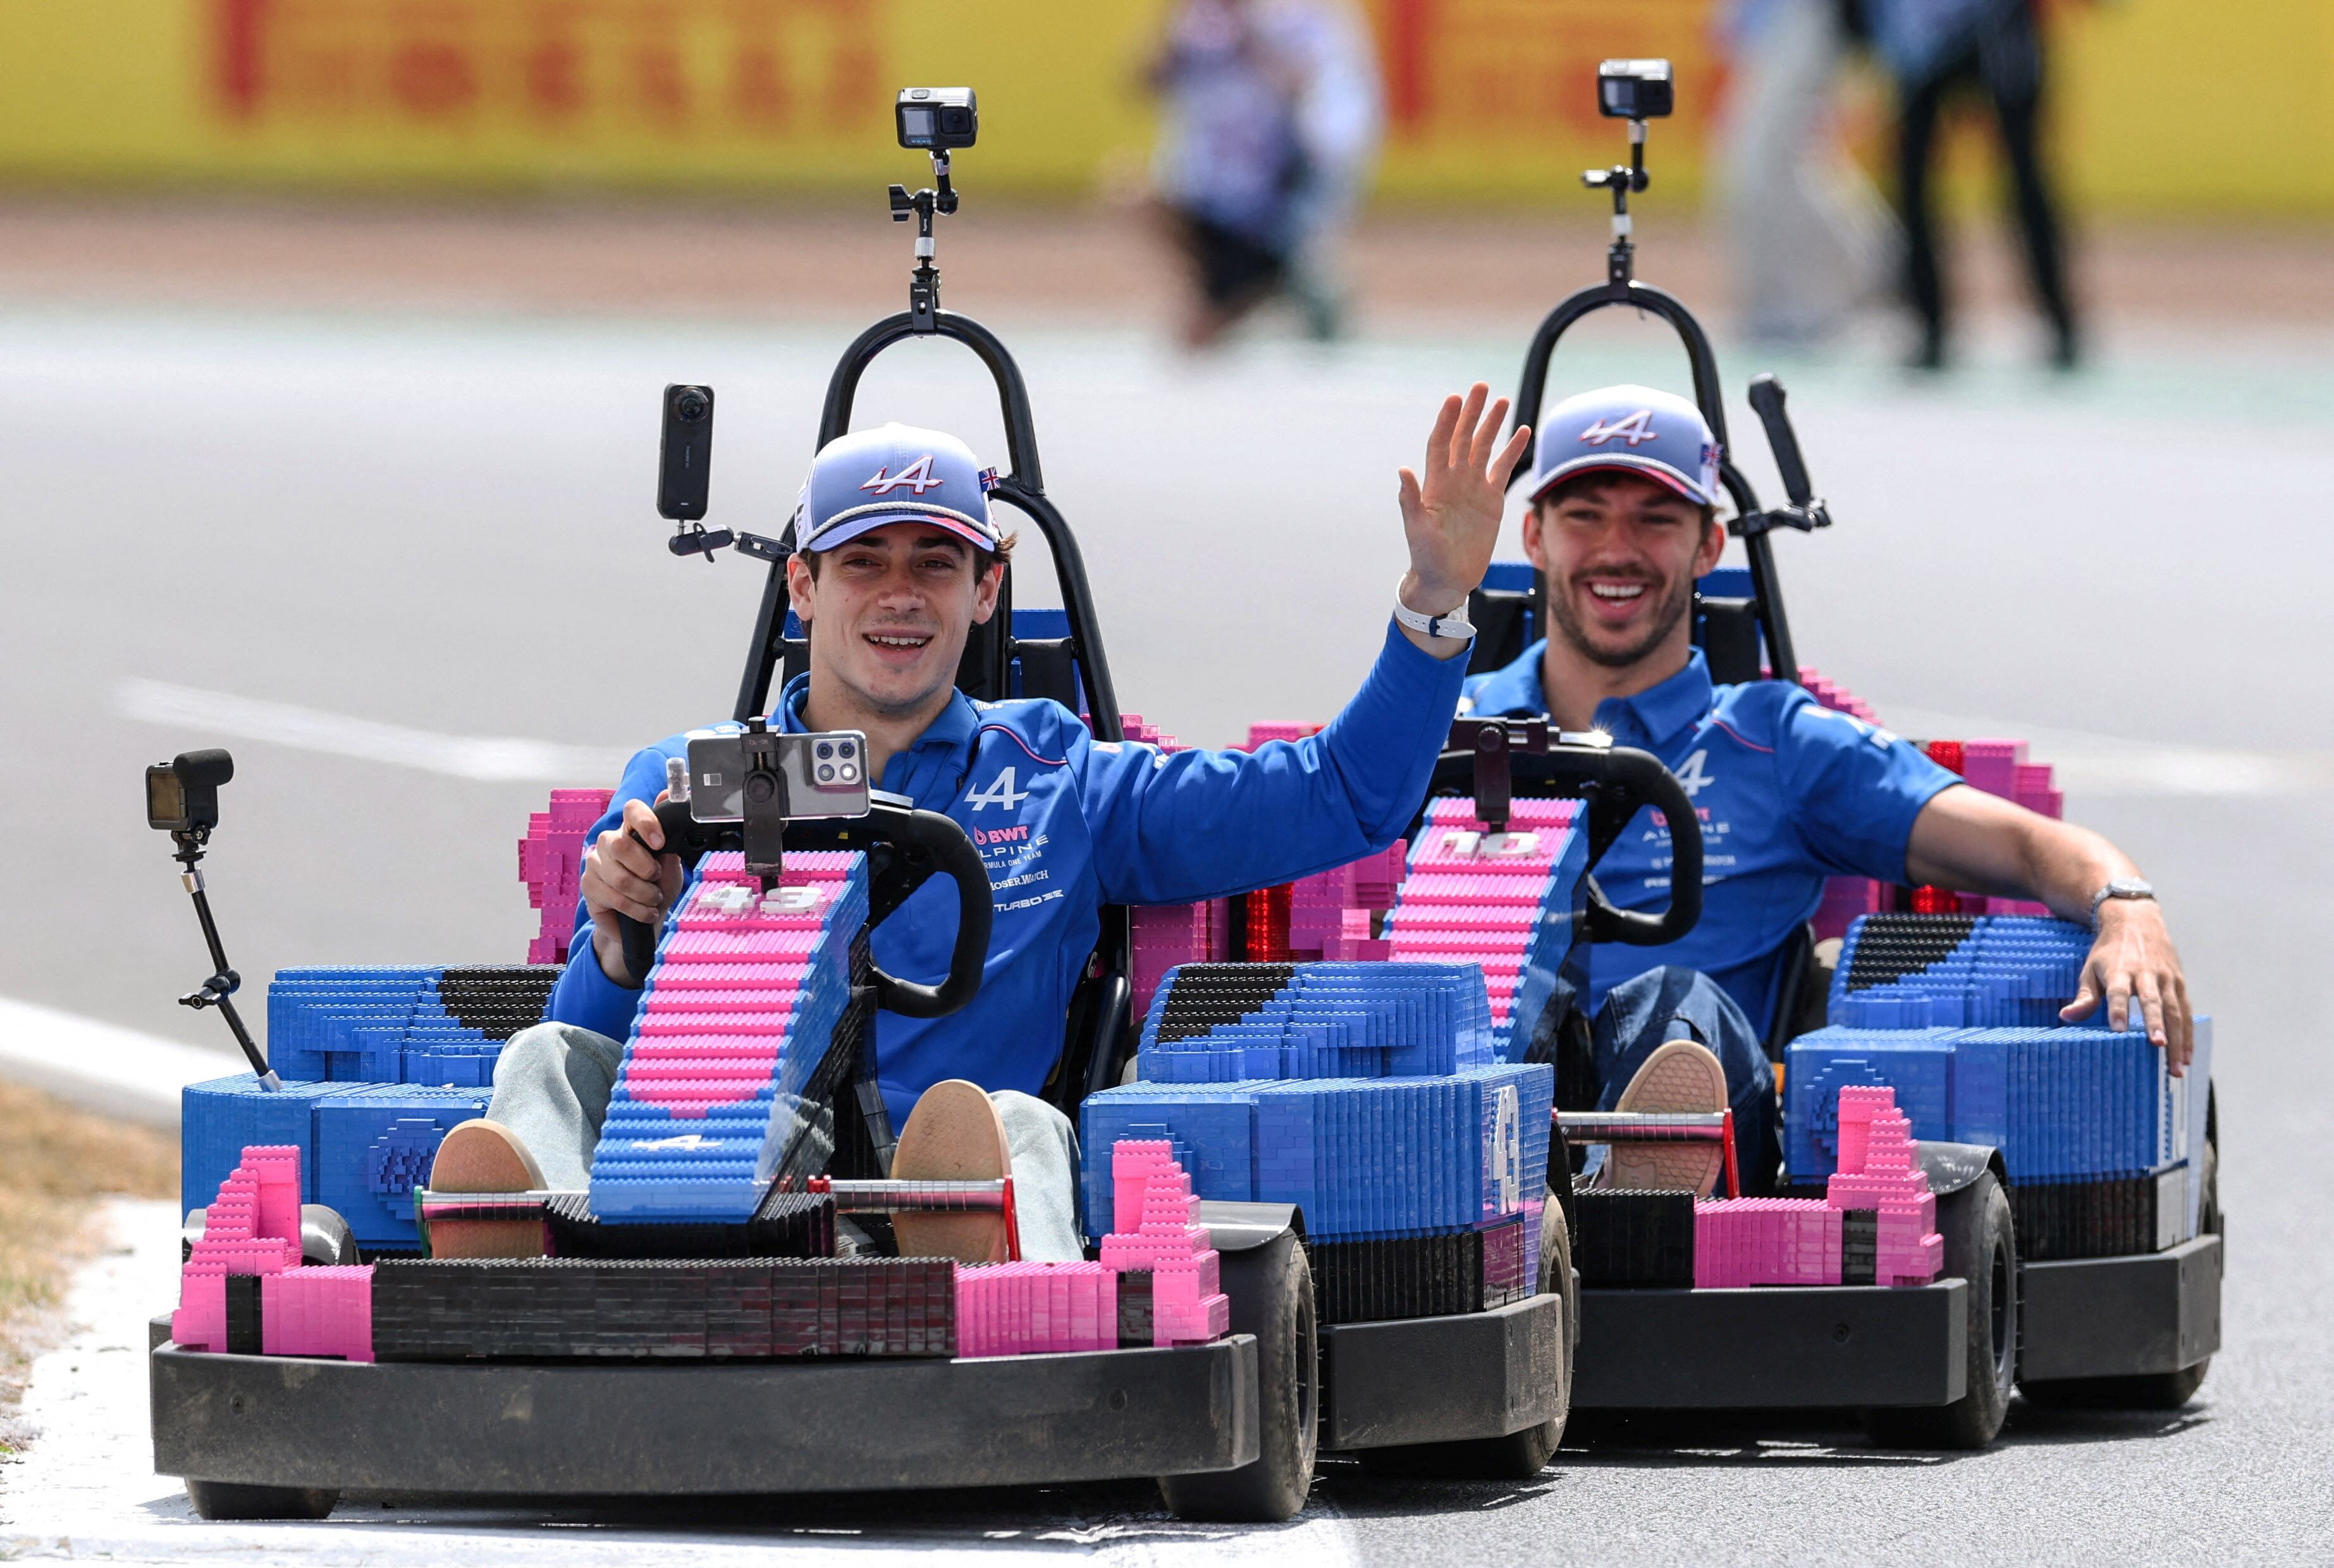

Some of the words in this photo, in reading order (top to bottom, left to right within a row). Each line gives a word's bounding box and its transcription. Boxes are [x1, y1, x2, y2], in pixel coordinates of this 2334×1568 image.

[987, 825, 1028, 844] BWT
[979, 834, 1049, 859] LPINE
[1008, 858, 1022, 867] ONE
[1023, 850, 1042, 862] TEAM
[698, 886, 822, 915] 43
[993, 896, 1043, 912] TURBO
